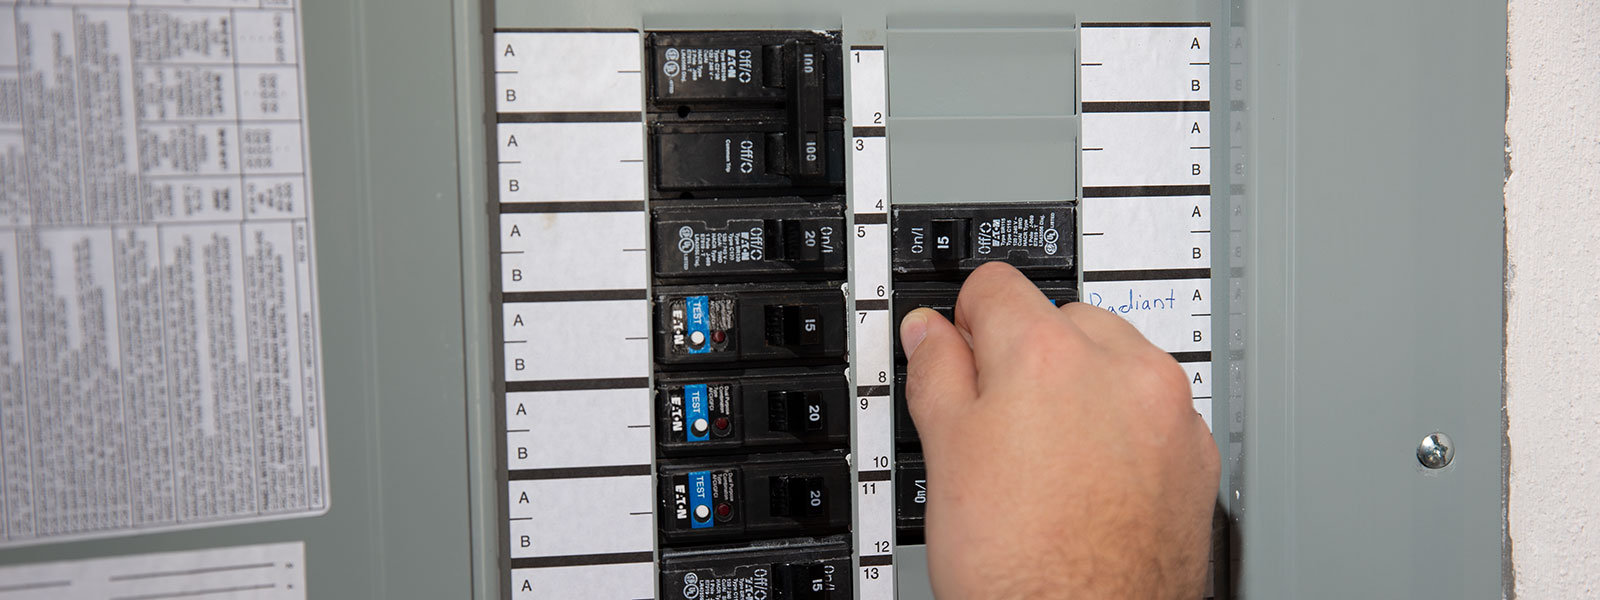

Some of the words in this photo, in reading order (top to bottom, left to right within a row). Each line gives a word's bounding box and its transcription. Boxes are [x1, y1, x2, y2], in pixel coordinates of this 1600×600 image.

[1191, 38, 1200, 49] A
[505, 45, 514, 56] A
[855, 52, 859, 63] 1
[804, 53, 815, 74] 100
[1192, 80, 1200, 91] B
[507, 90, 516, 101] B
[874, 112, 881, 123] 2
[1191, 122, 1200, 133] A
[508, 135, 517, 146] A
[856, 139, 864, 151] 3
[806, 141, 816, 161] 100
[1192, 164, 1200, 175] B
[510, 180, 519, 191] B
[876, 199, 883, 210] 4
[1192, 206, 1201, 217] A
[511, 225, 520, 236] A
[858, 226, 865, 237] 5
[804, 230, 816, 247] 20
[937, 236, 950, 250] 15
[1193, 248, 1201, 259] B
[513, 270, 522, 281] B
[877, 285, 884, 297] 6
[1193, 290, 1201, 301] A
[693, 302, 701, 324] TEST
[859, 312, 867, 323] 7
[514, 314, 523, 326] A
[805, 318, 816, 332] 15
[1193, 331, 1201, 342] B
[515, 359, 525, 370] B
[879, 371, 886, 383] 8
[1193, 372, 1202, 383] A
[692, 391, 700, 413] TEST
[860, 398, 868, 410] 9
[516, 403, 526, 415] A
[808, 405, 820, 422] 20
[518, 447, 528, 459] B
[874, 456, 888, 468] 10
[696, 476, 705, 498] TEST
[863, 483, 875, 494] 11
[519, 492, 529, 503] A
[810, 490, 821, 507] 20
[521, 536, 530, 547] B
[875, 541, 889, 552] 12
[864, 568, 879, 579] 13
[522, 580, 532, 591] A
[811, 579, 823, 592] 15
